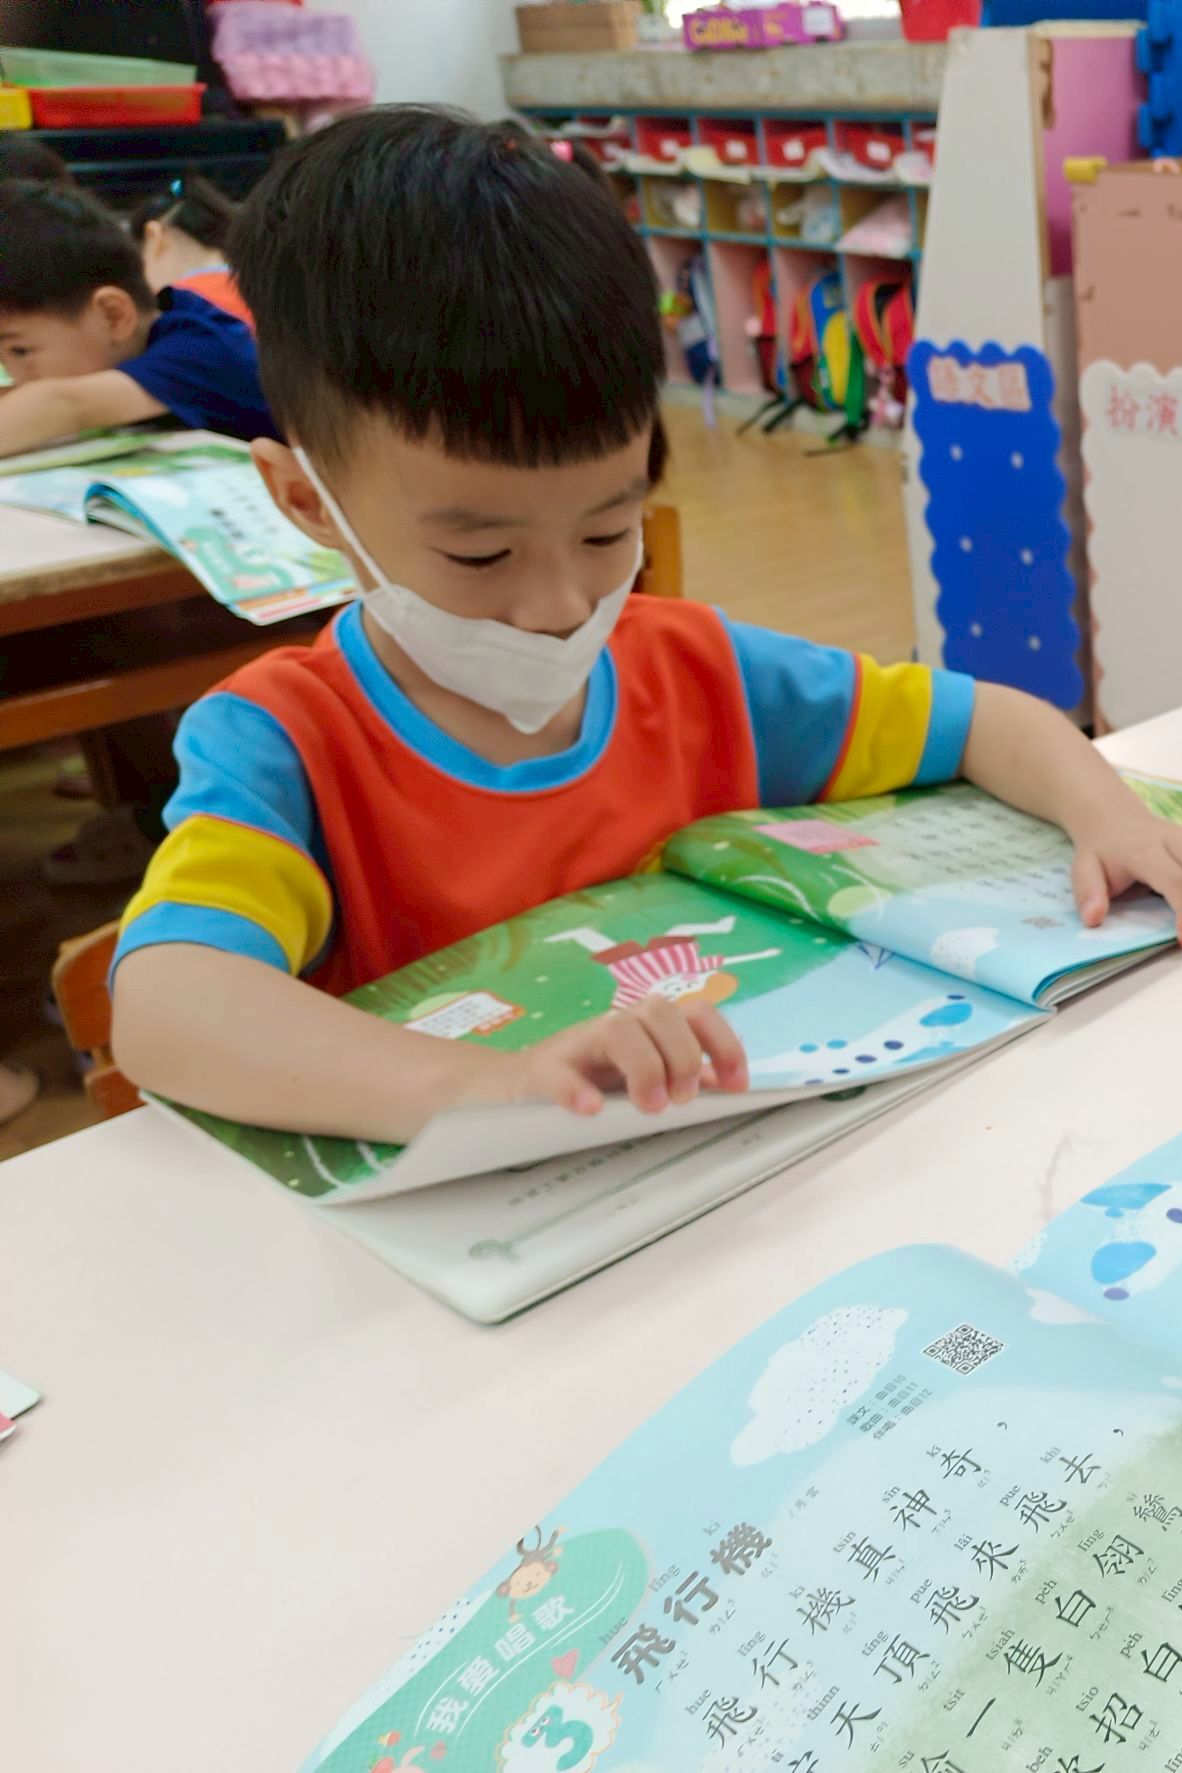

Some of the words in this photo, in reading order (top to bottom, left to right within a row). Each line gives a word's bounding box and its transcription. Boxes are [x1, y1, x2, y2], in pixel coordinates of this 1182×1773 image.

[426, 1594, 576, 1734] 我愛唱歌
[611, 1522, 772, 1684] 飛行機
[685, 1689, 711, 1716] hue
[833, 1530, 856, 1554] tsin
[807, 1685, 840, 1721] thinn
[911, 1577, 932, 1604] pue
[1000, 1484, 1021, 1507] pue
[985, 1627, 1015, 1661] tsiah
[521, 1704, 594, 1772] 3
[1075, 1686, 1099, 1712] tsio
